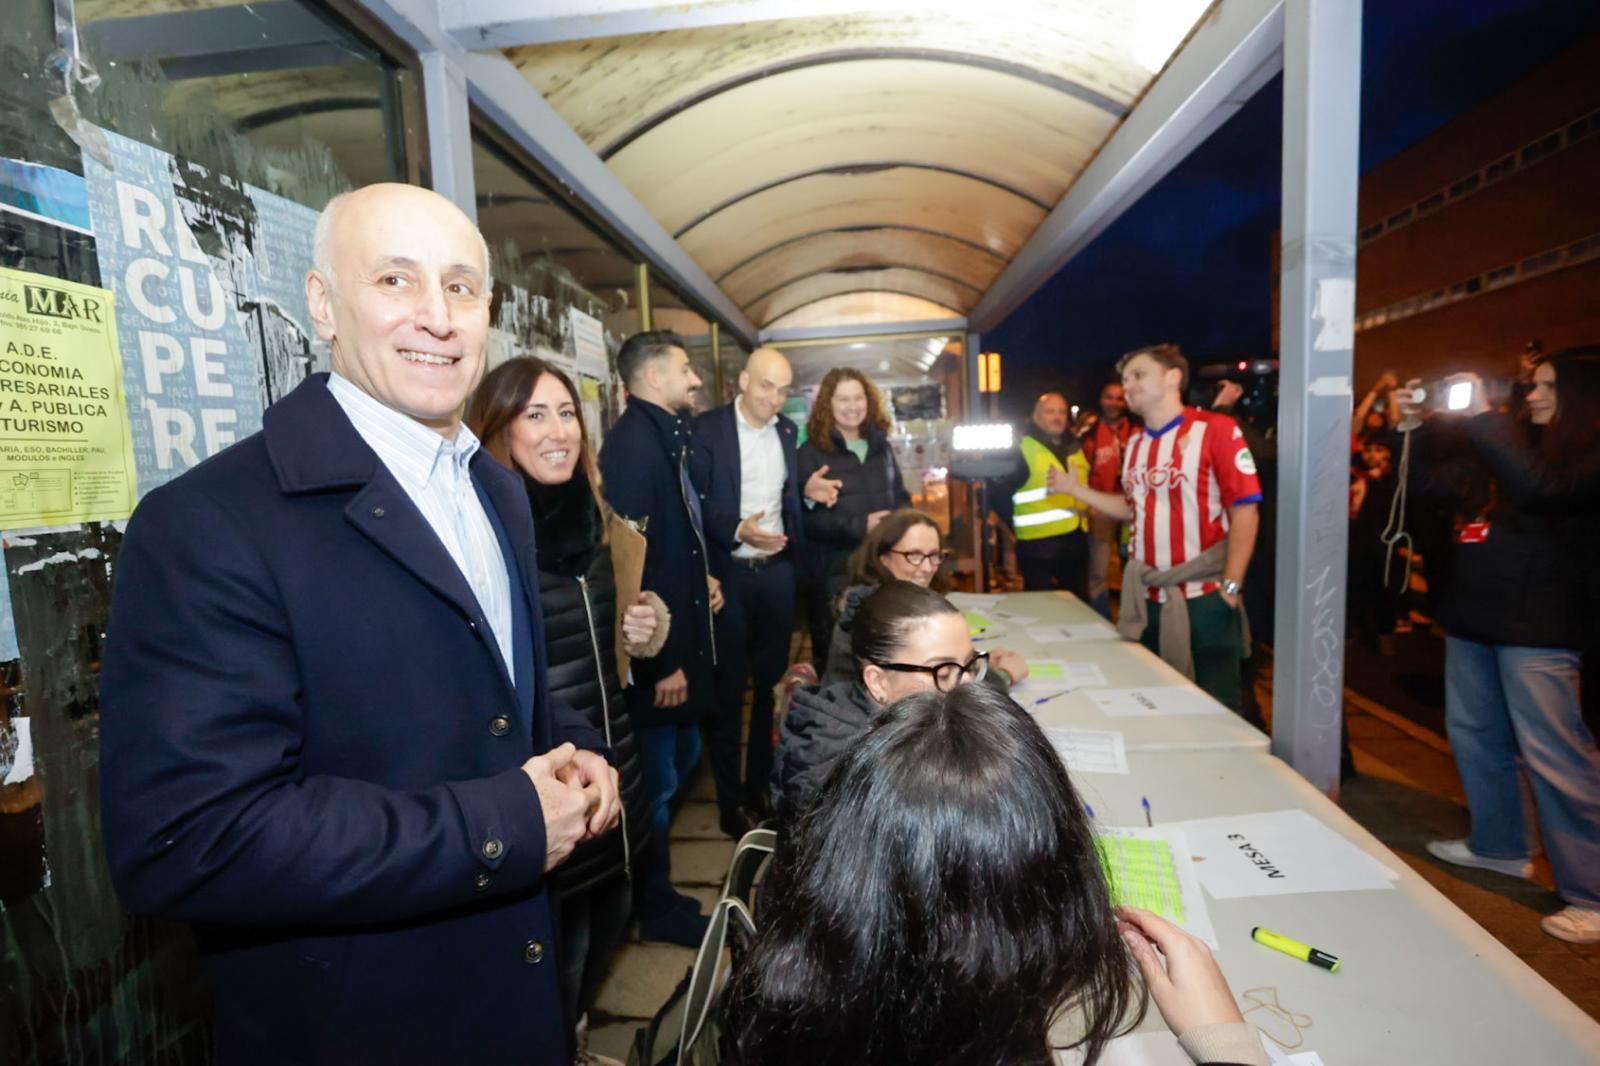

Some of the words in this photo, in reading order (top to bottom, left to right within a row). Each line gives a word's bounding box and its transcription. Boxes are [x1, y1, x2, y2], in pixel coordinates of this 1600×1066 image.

[25, 285, 101, 323] MAR
[124, 258, 227, 331] CU
[6, 341, 57, 360] A.D.E.
[139, 331, 234, 398] PE
[9, 399, 28, 413] A.
[32, 401, 108, 417] PUBLICA
[0, 418, 84, 434] TURISMO
[1227, 833, 1246, 841] 3
[1239, 843, 1286, 879] MESA
